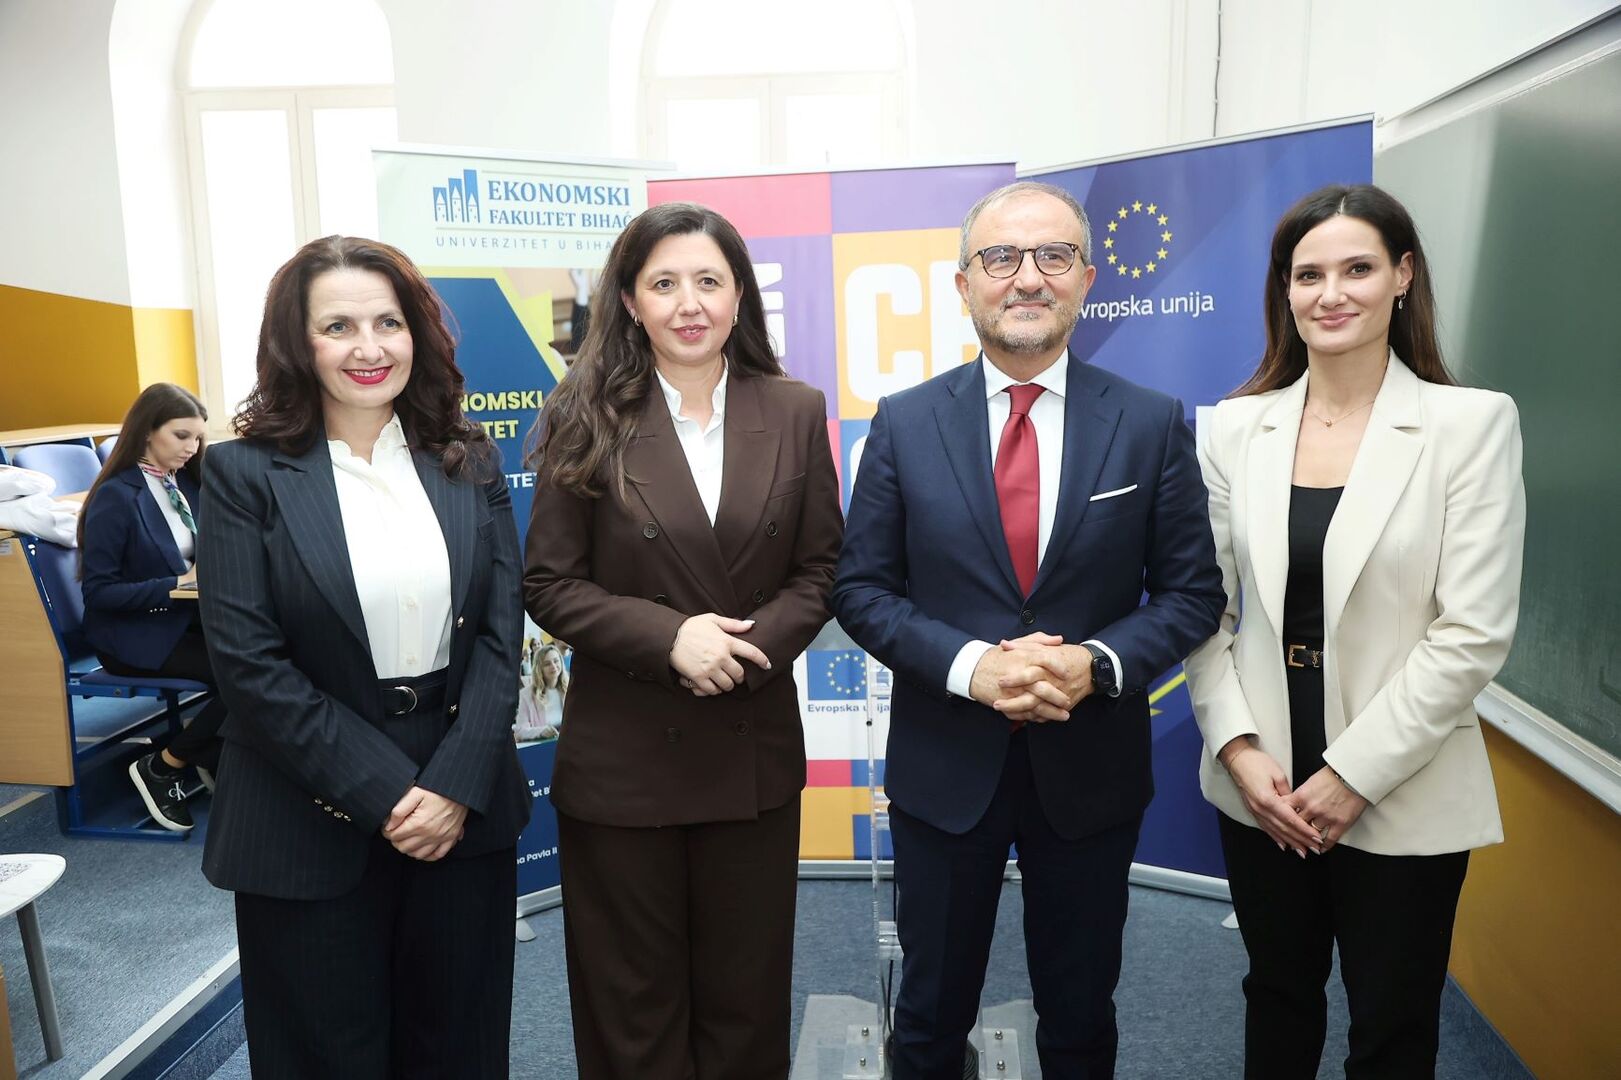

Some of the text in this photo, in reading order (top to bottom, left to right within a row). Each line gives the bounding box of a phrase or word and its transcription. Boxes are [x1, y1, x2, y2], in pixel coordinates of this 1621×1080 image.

[488, 180, 630, 206] EKONOMSKI
[489, 209, 576, 228] FAKULTET
[436, 236, 612, 250] UNIVERZITET U BIHA
[1161, 291, 1215, 318] unija
[807, 703, 859, 714] Evropska
[526, 849, 551, 862] Pavla
